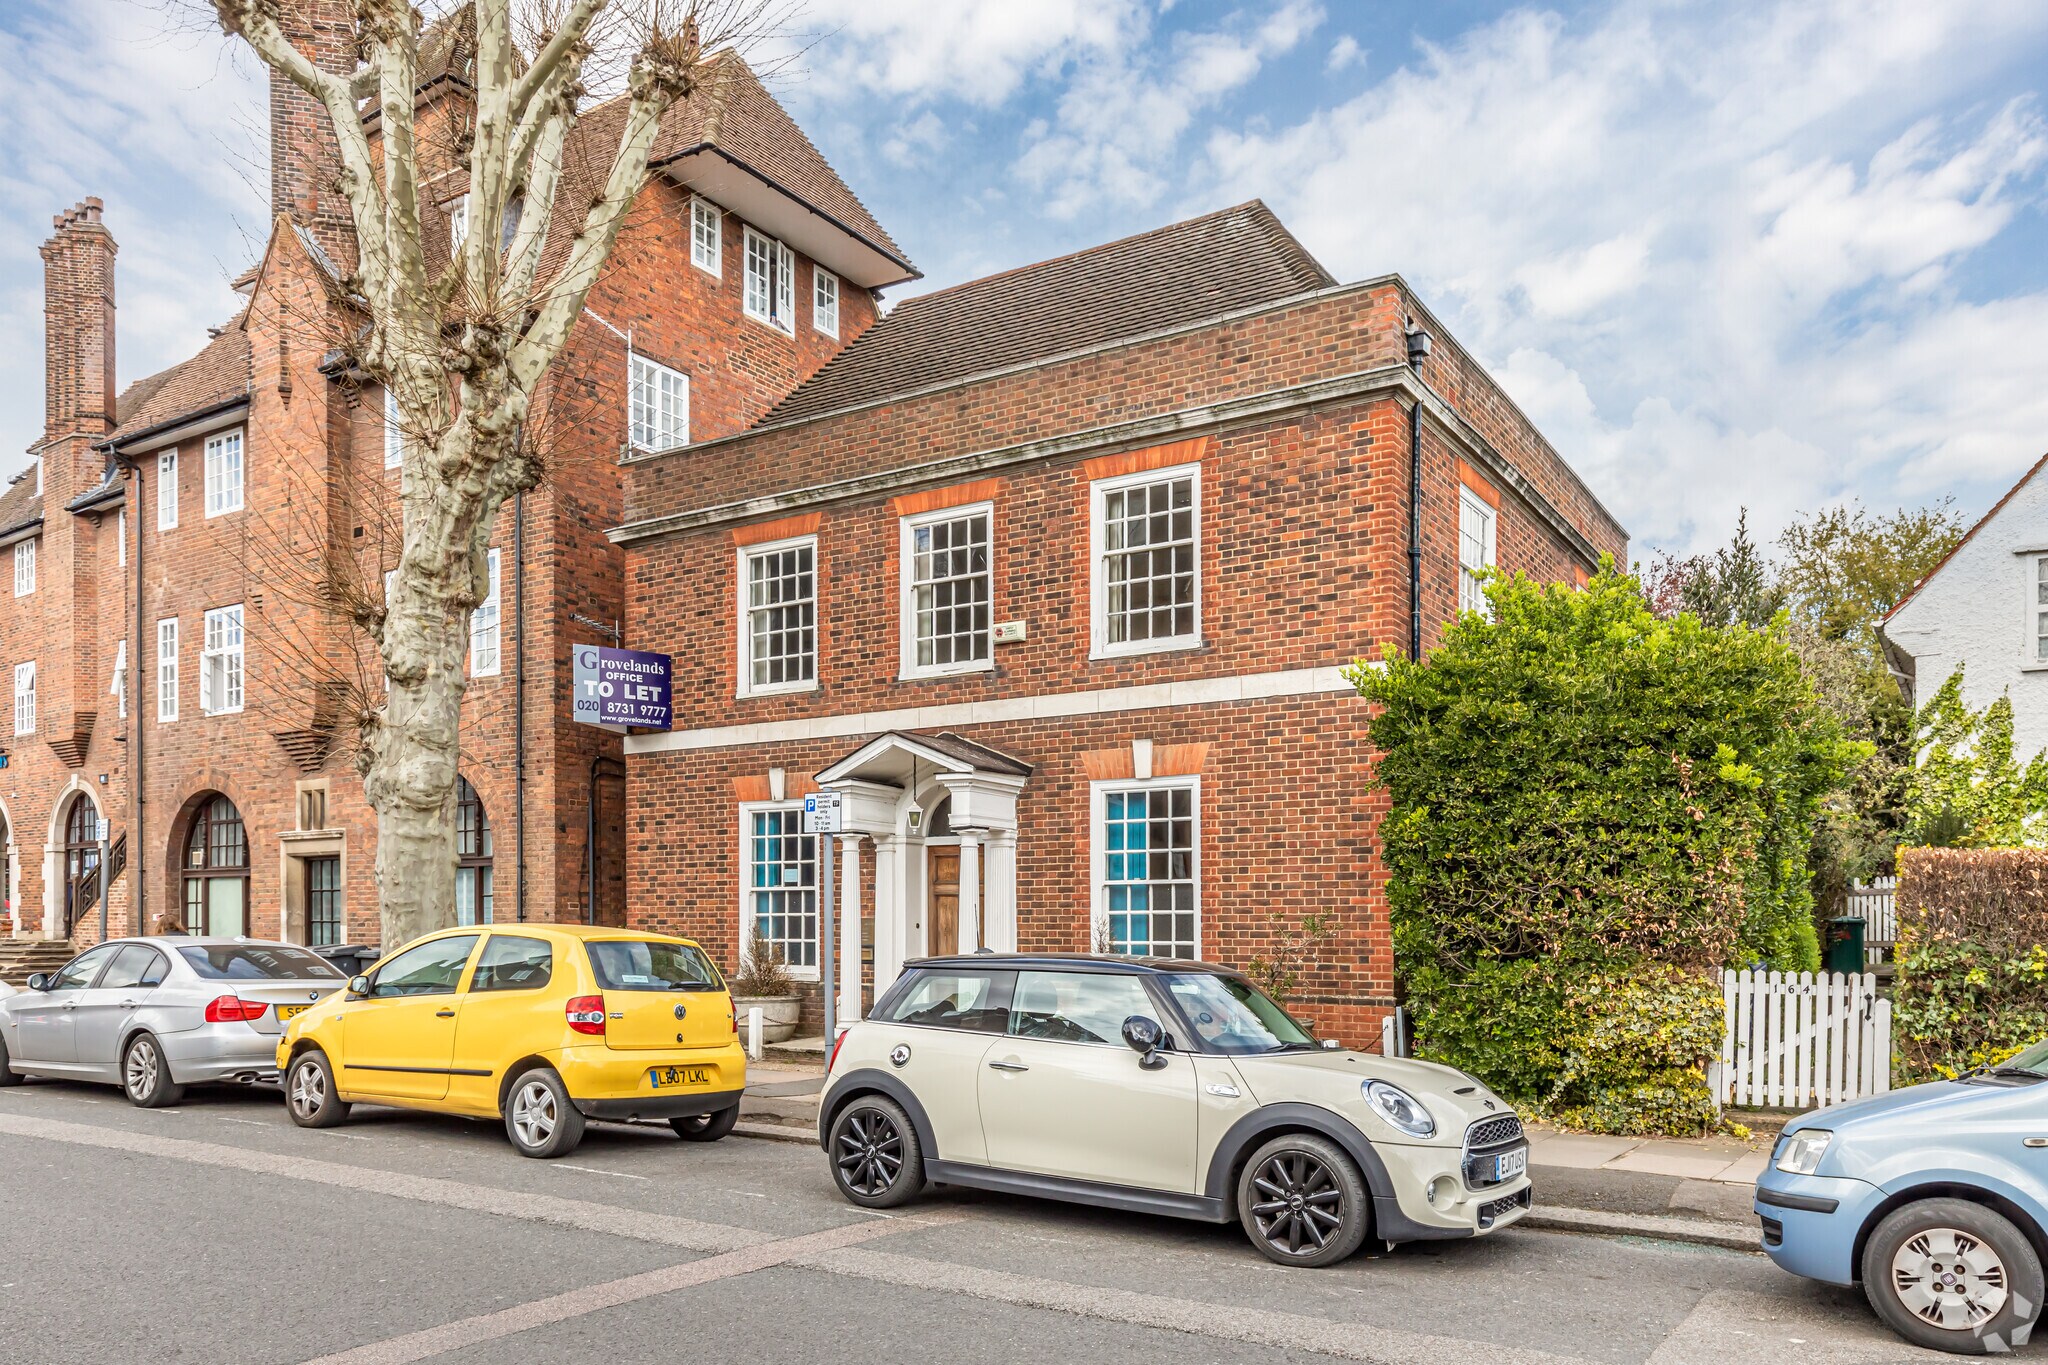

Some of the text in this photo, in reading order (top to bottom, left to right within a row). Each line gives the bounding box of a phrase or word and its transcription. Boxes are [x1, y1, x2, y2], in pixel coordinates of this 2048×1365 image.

[580, 651, 664, 675] Grovelands
[606, 671, 643, 683] OFFICE
[584, 680, 662, 702] TO LET
[577, 700, 666, 717] 020 8731 9777
[601, 715, 662, 725] www.grovelands.net
[688, 1070, 709, 1083] LKL
